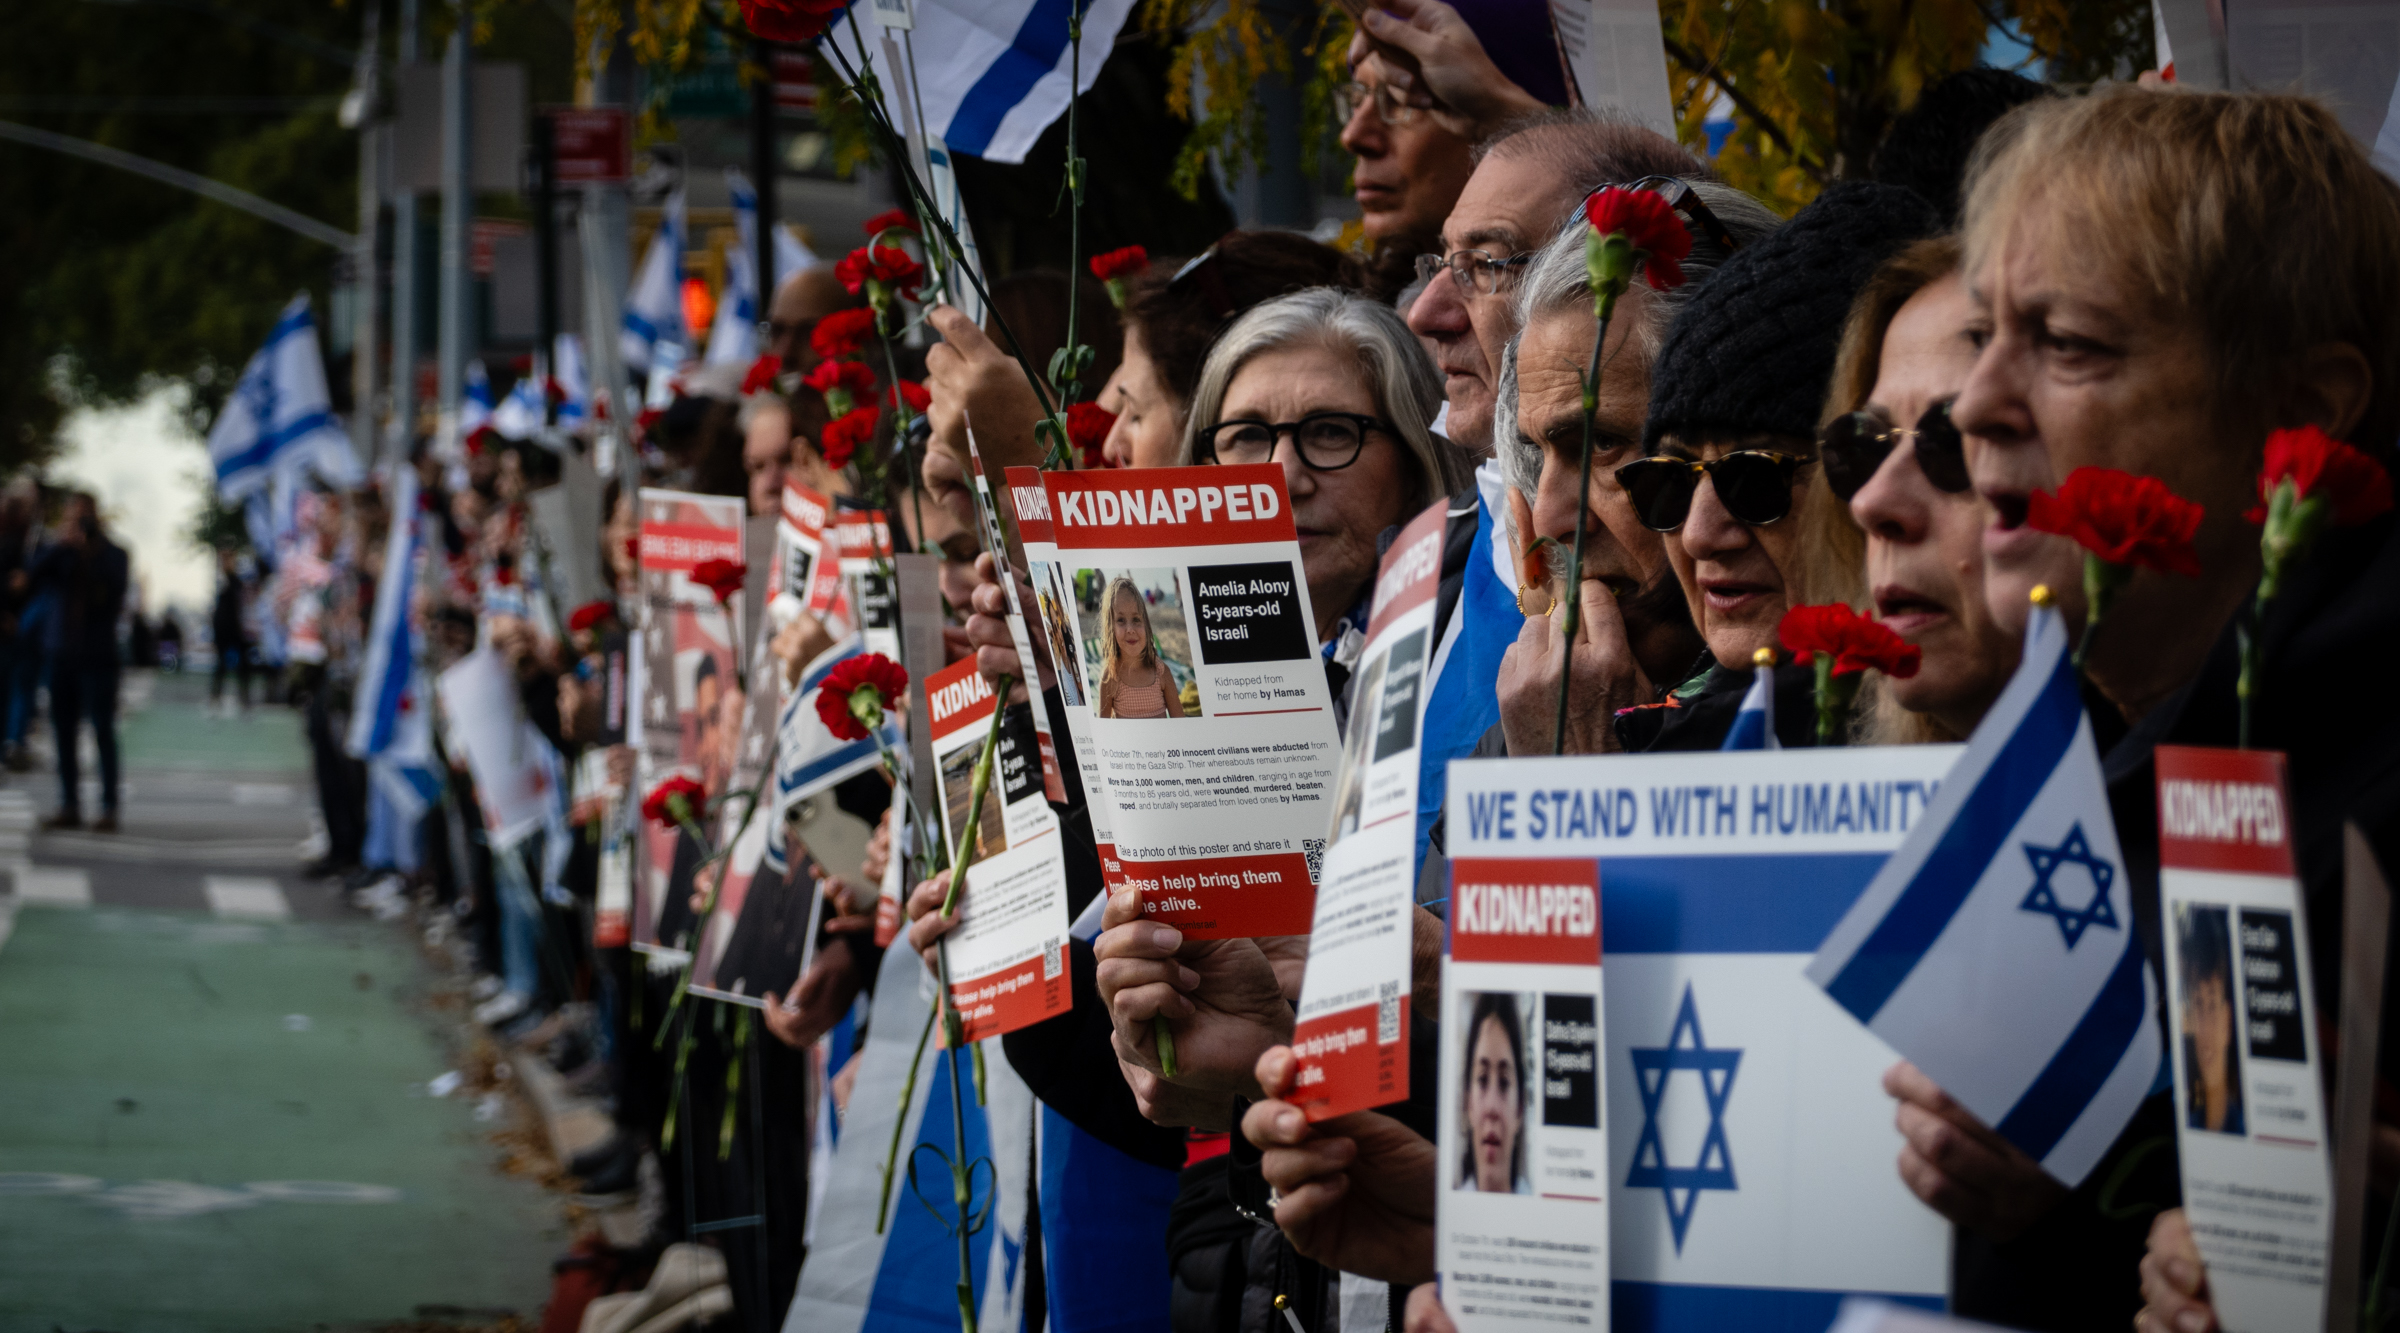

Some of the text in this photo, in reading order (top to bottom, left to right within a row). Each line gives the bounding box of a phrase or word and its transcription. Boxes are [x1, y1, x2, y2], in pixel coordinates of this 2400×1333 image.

[1057, 484, 1280, 527] KIDNAPPED
[1199, 579, 1290, 597] Amelia Alony
[1202, 600, 1281, 622] 5-years-old
[1205, 624, 1249, 641] Israeli
[1214, 674, 1284, 687] Kidnapped from
[931, 671, 993, 723] KIDNA
[1217, 688, 1306, 701] her home by Hamas
[1101, 748, 1109, 757] On
[1109, 748, 1131, 759] October
[1145, 750, 1165, 760] nearly
[1167, 749, 1180, 758] 200
[1182, 748, 1215, 757] innocent
[1217, 746, 1250, 756] civilians
[1251, 745, 1271, 753] were
[1272, 742, 1310, 752] abducted
[1311, 741, 1329, 750] from
[1110, 753, 1320, 771] Israel into the Gaza Strip. Their whereabouts remain unknown.
[1005, 771, 1027, 794] Israeli
[1107, 769, 1332, 788] More than 3,000 women, men, and children, ranging in age from
[1118, 789, 1139, 799] months
[1139, 790, 1146, 798] to
[1158, 790, 1177, 800] years
[1178, 789, 1192, 798] old,
[1193, 788, 1212, 796] were
[1213, 785, 1252, 795] wounded,
[1253, 783, 1295, 793] murdered,
[1119, 802, 1137, 811] raped,
[1138, 801, 1152, 810] and
[1152, 800, 1179, 811] brutally
[1180, 798, 1218, 810] separated
[1218, 798, 1236, 806] from
[1237, 796, 1259, 806] loved
[1260, 796, 1279, 804] ones
[1279, 794, 1290, 804] by
[1466, 790, 1517, 841] WE
[1527, 787, 1638, 841] STAND
[1650, 785, 1739, 837] WITH
[1750, 778, 1939, 835] HUMANITY
[2160, 779, 2282, 846] KIDNAPPED
[1119, 838, 1291, 859] Take a photo of this poster and share it
[1162, 874, 1196, 892] help
[1199, 872, 1241, 889] bring
[1242, 870, 1282, 885] them
[1161, 896, 1201, 912] alive.
[1457, 883, 1598, 937] KIDNAPPED
[979, 984, 997, 1000] help
[997, 979, 1017, 995] bring
[1017, 971, 1035, 988] them
[1307, 1035, 1324, 1058] help
[1325, 1031, 1347, 1054] bring
[1347, 1027, 1368, 1047] them
